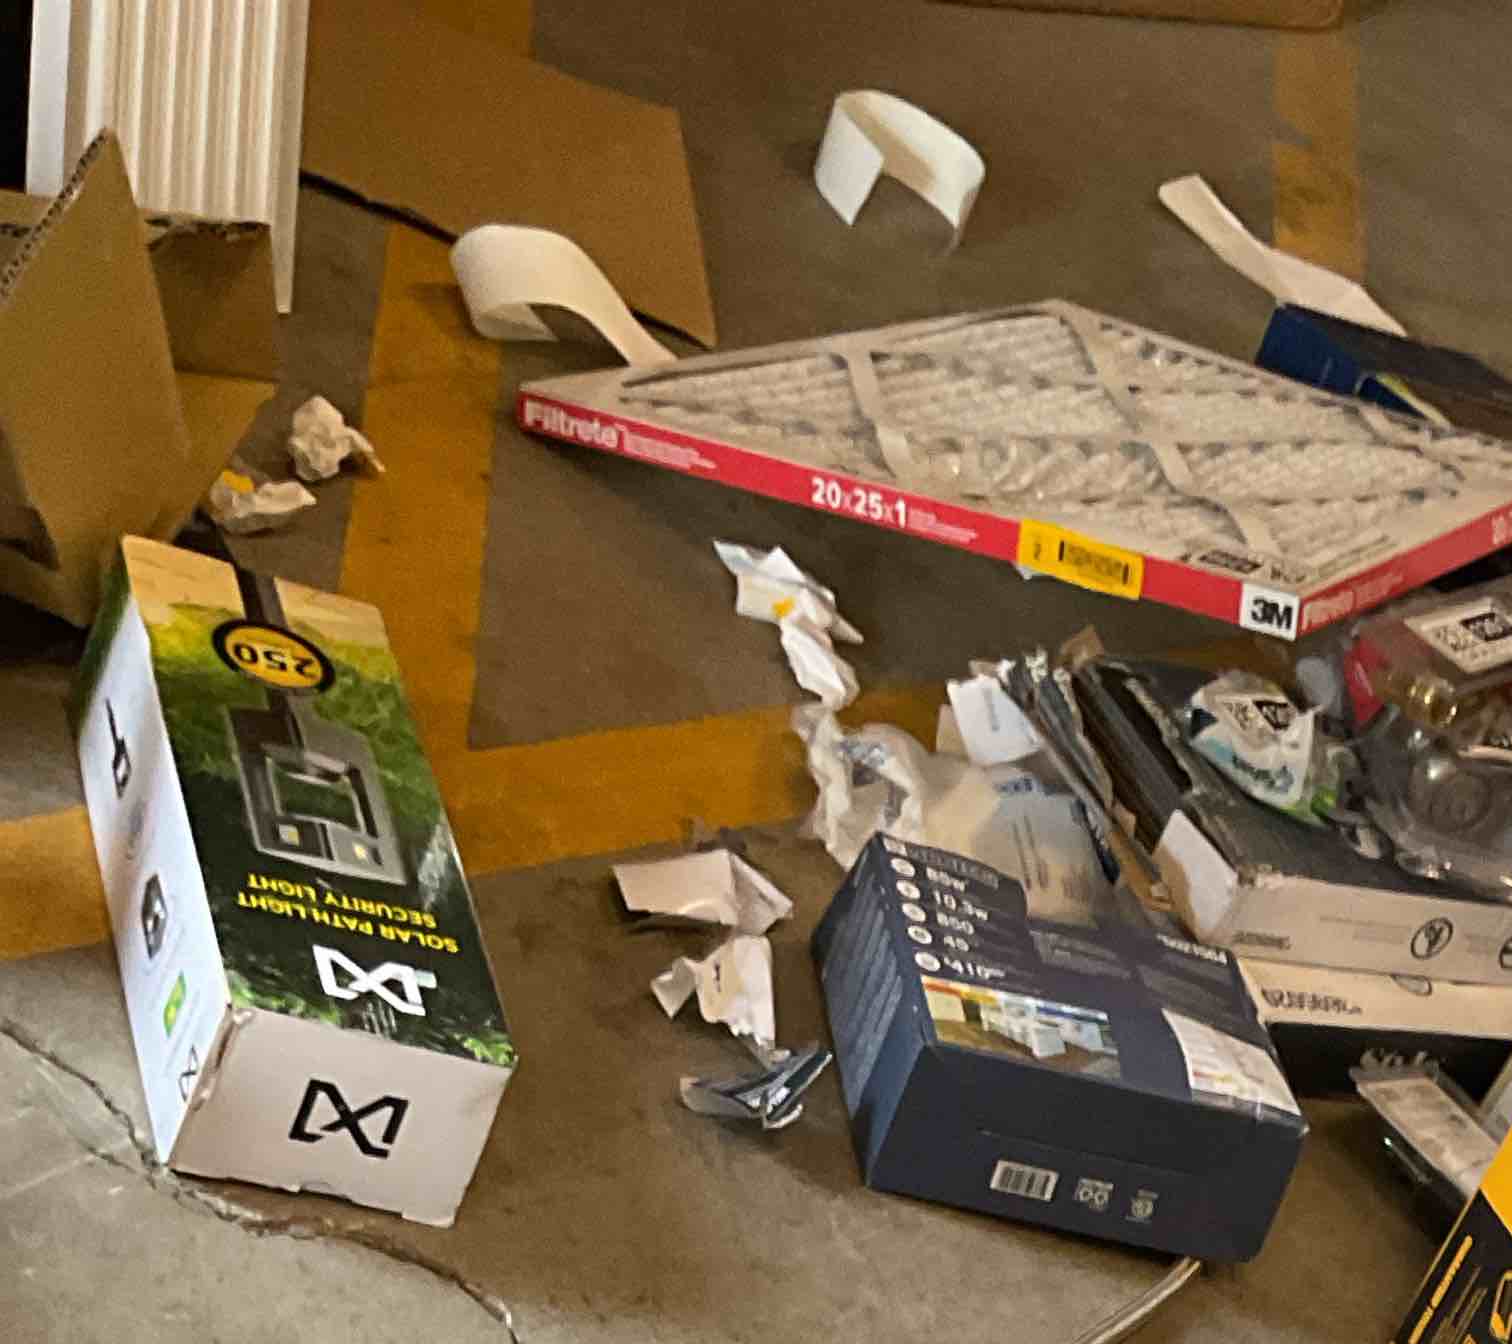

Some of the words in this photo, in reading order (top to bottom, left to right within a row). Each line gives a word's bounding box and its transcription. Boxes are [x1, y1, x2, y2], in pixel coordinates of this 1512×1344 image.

[523, 401, 618, 450] Filtrete
[1251, 600, 1292, 630] 3M
[233, 642, 315, 677] 250
[248, 872, 317, 900] LIGHT
[237, 891, 309, 921] LIGHT
[323, 890, 439, 930] SECURITY
[311, 908, 374, 937] PATH
[378, 923, 458, 953] SOLAR
